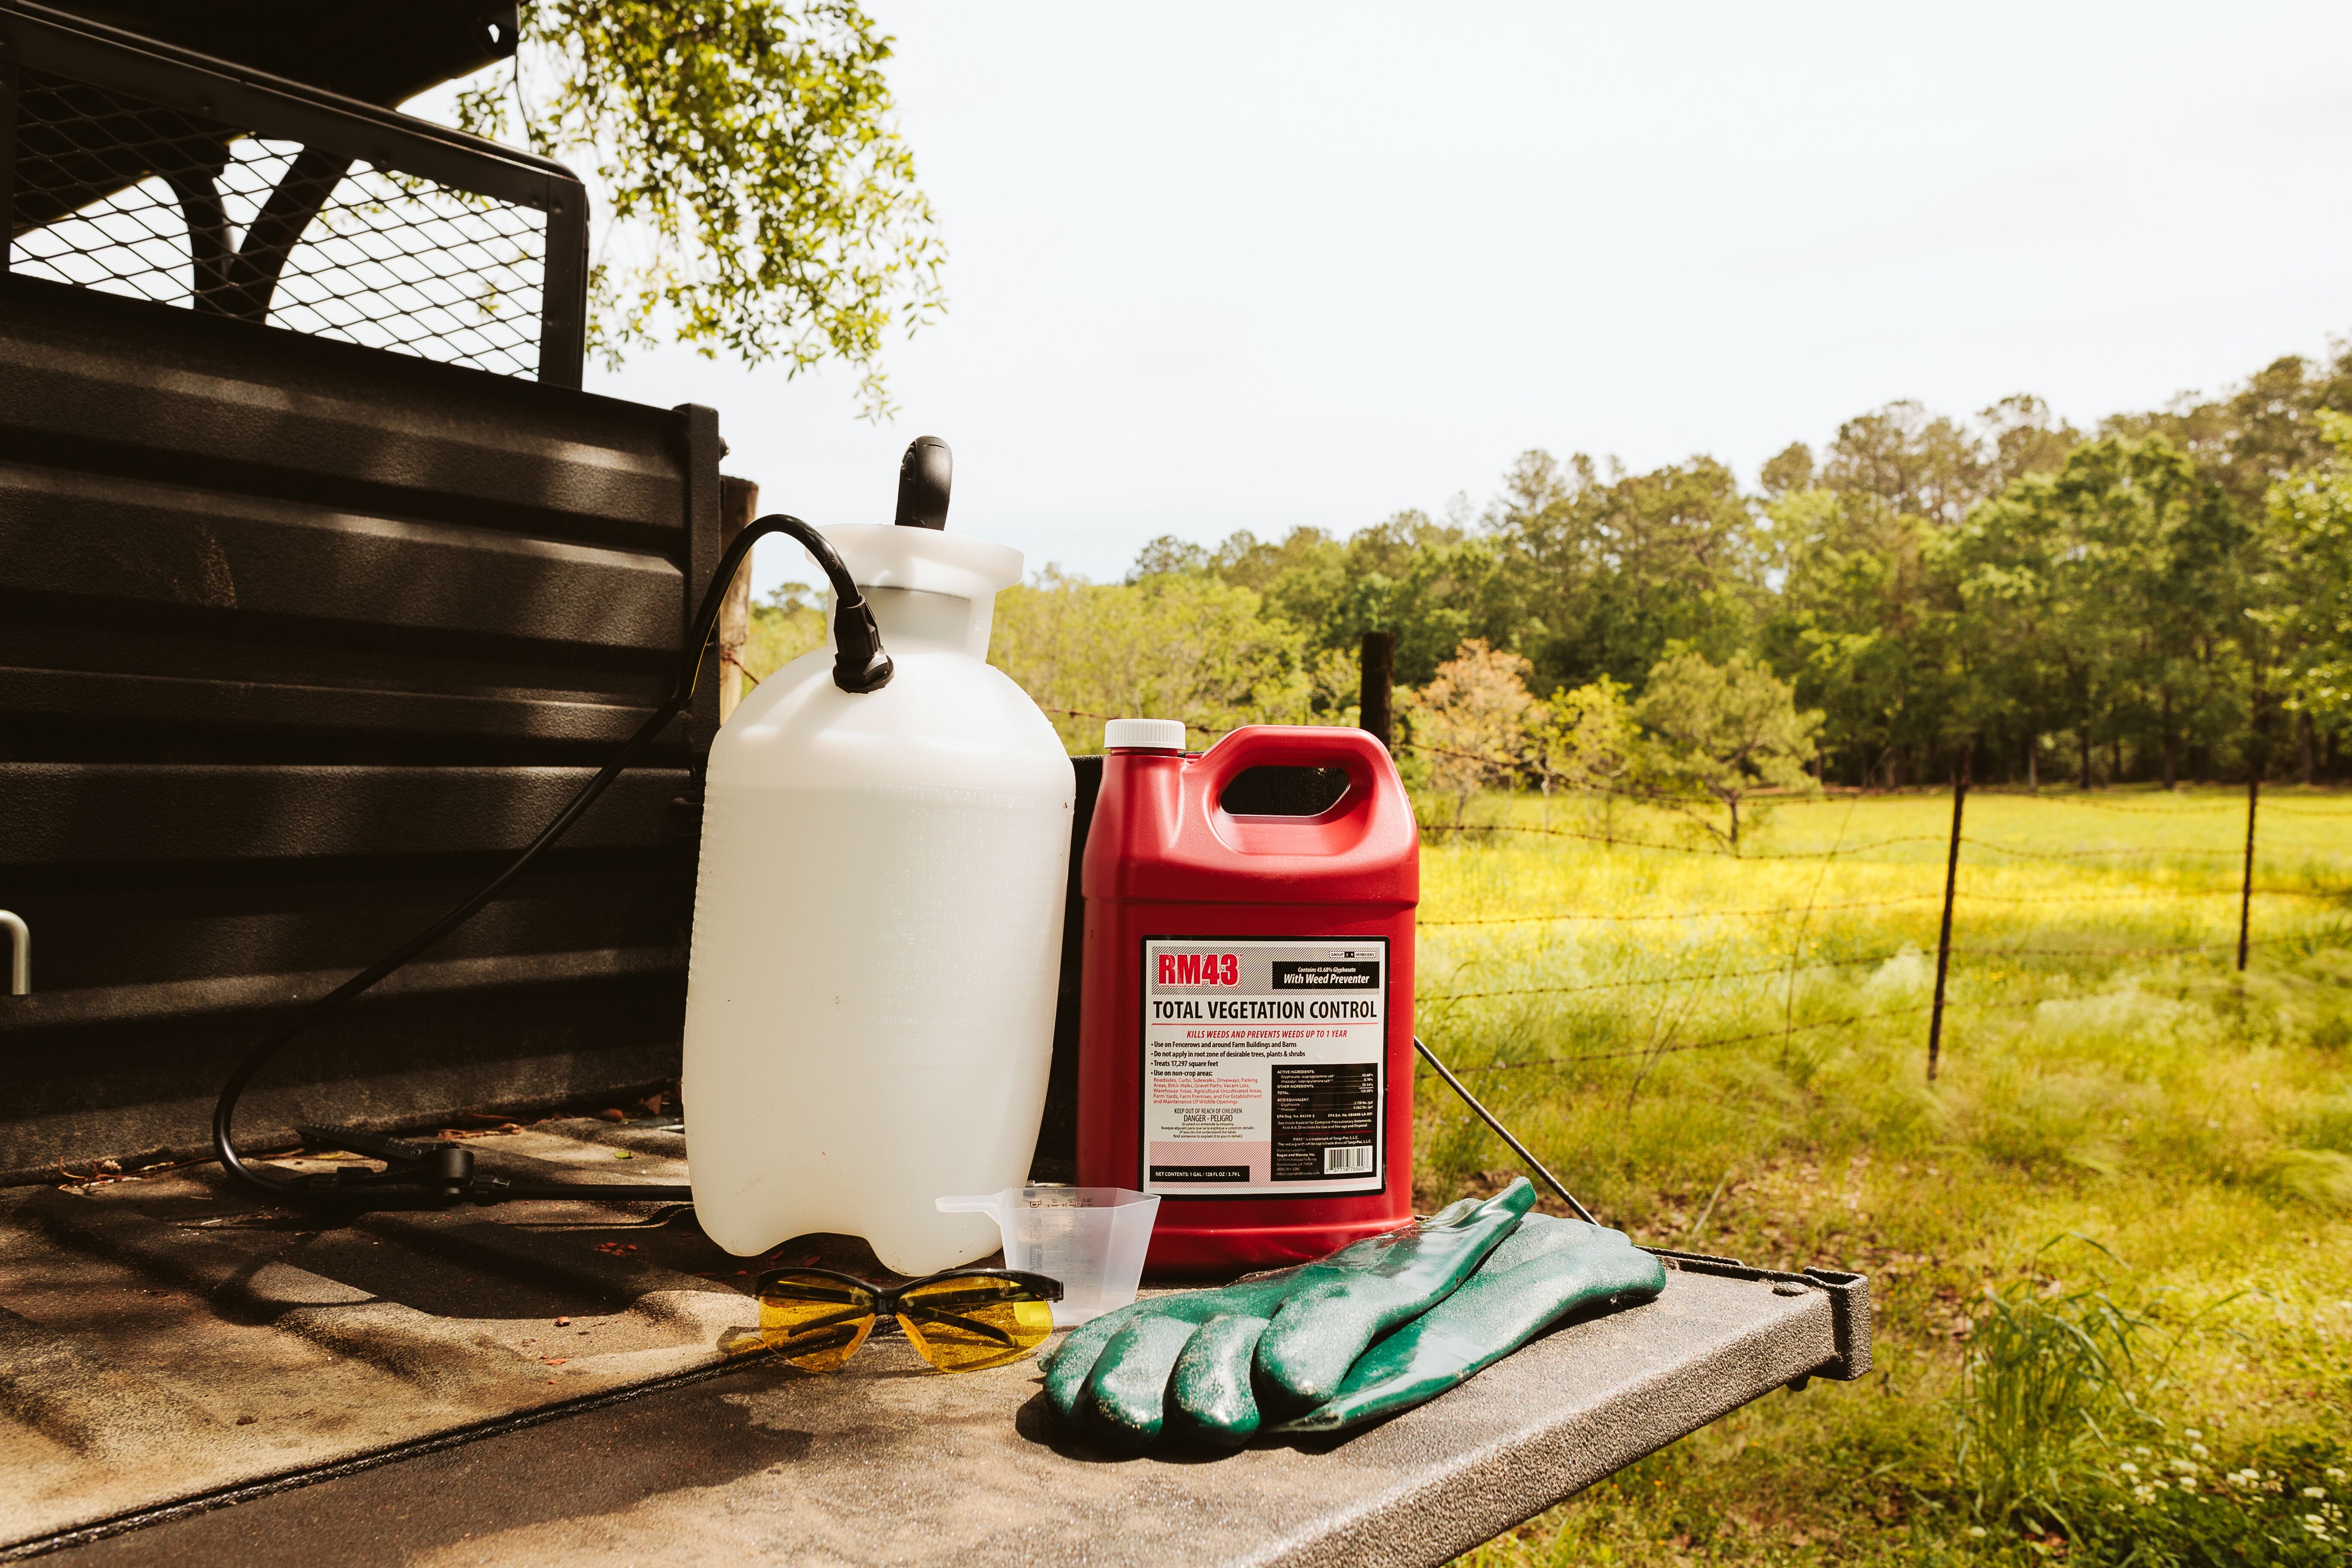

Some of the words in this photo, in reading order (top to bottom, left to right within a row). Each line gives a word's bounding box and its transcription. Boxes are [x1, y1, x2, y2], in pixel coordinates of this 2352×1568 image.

[1284, 974, 1304, 983] With
[1306, 974, 1329, 983] Weed
[1330, 974, 1369, 983] Preventer
[1153, 1001, 1203, 1019] TOTAL
[1207, 1001, 1304, 1019] VEGETATION
[1310, 1001, 1377, 1018] CONTROL
